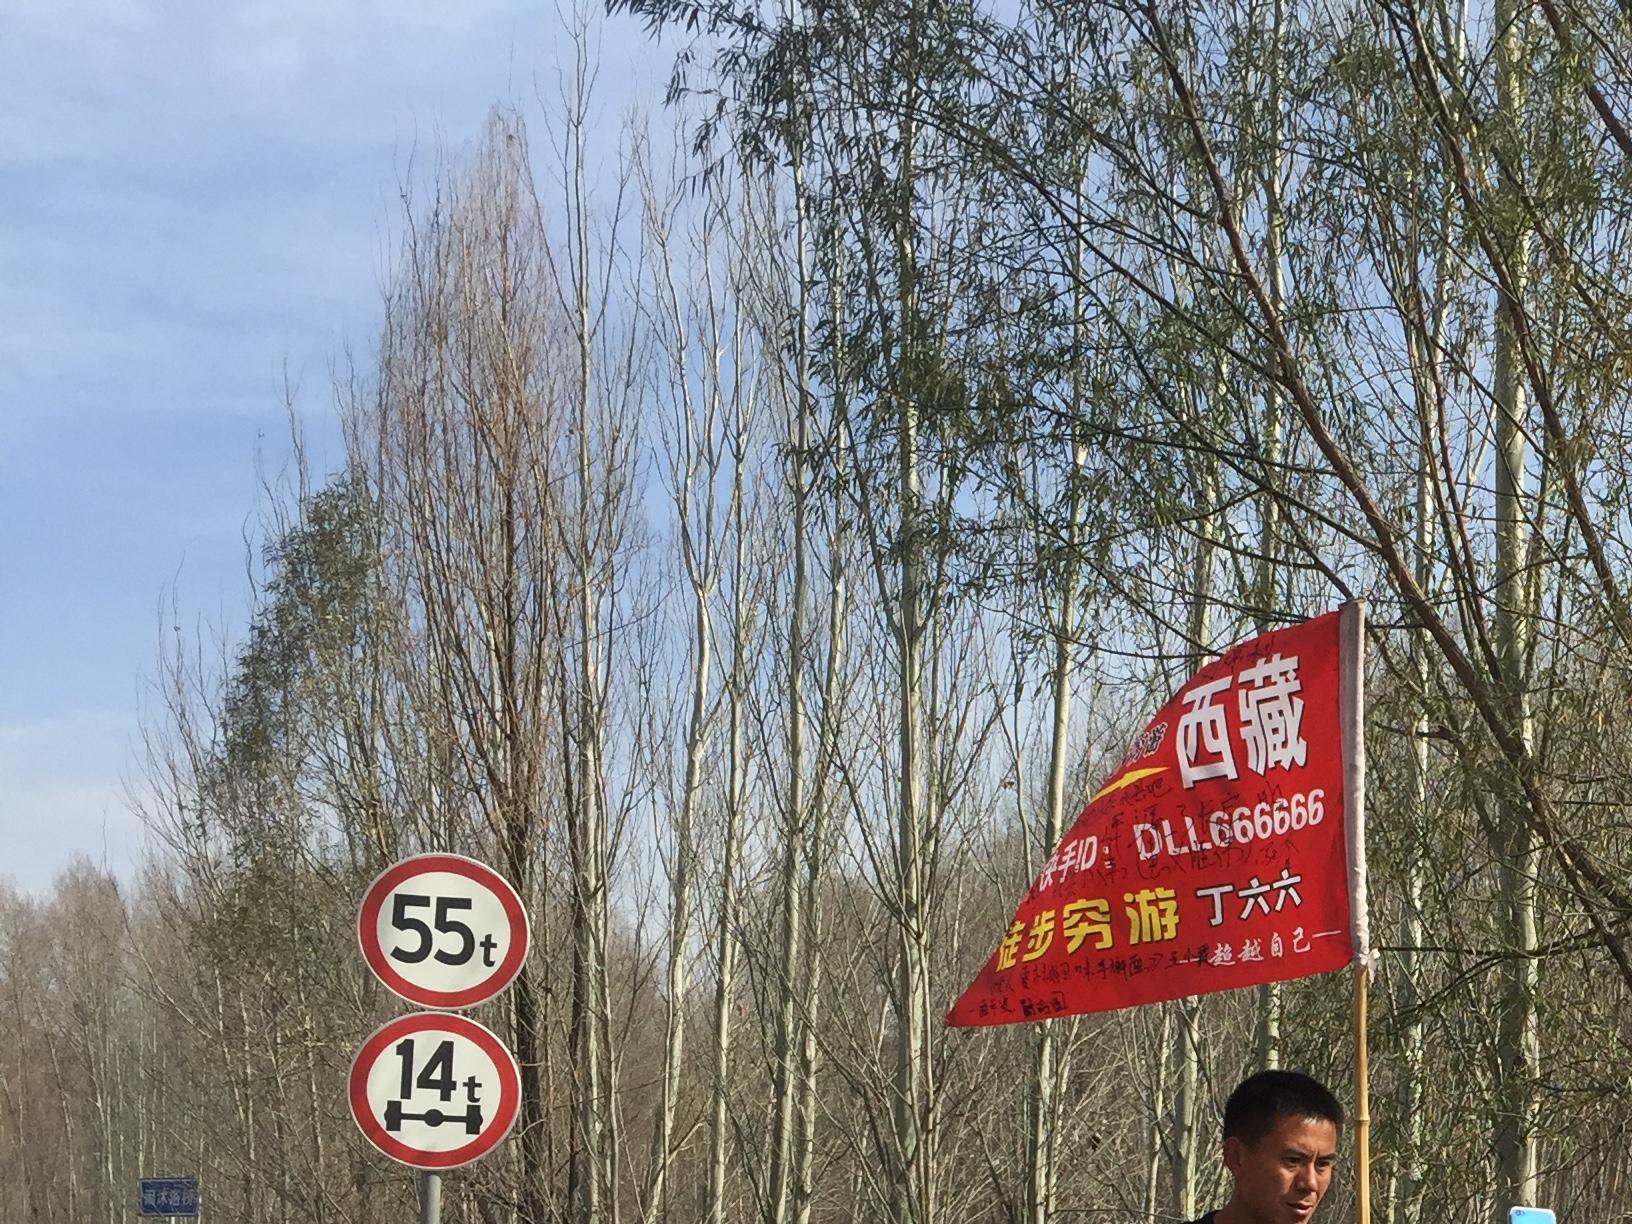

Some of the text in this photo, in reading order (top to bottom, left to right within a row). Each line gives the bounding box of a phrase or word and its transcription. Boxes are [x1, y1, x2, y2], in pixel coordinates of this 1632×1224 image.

[1176, 653, 1307, 789] 西藏
[1133, 789, 1324, 860] DLL666666
[1196, 868, 1302, 926] 丁六六
